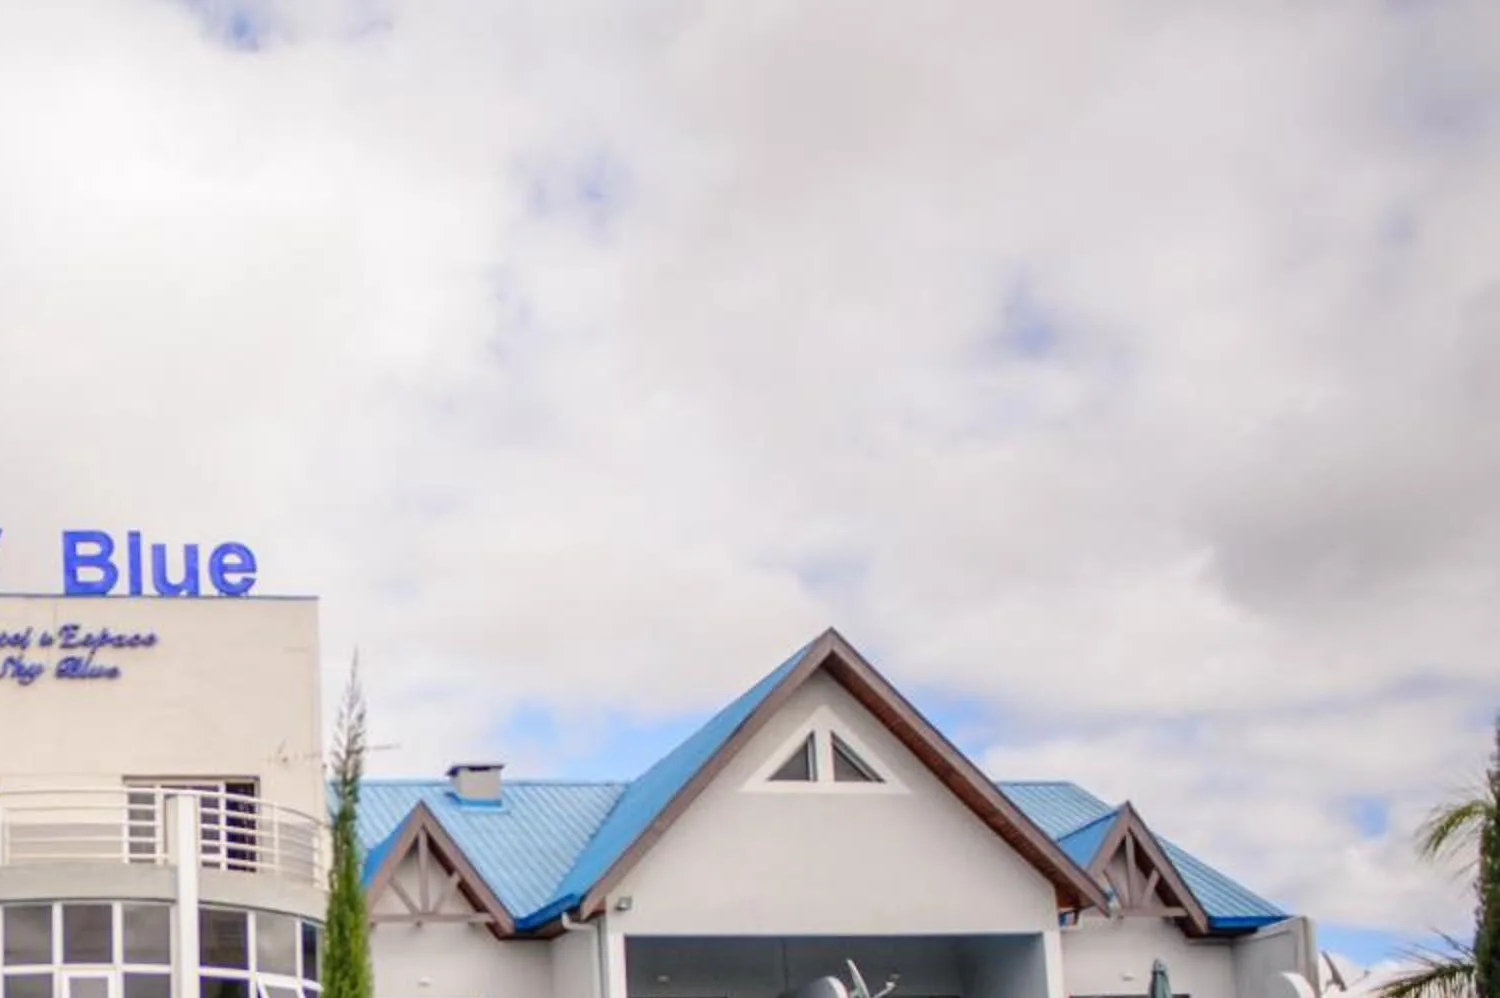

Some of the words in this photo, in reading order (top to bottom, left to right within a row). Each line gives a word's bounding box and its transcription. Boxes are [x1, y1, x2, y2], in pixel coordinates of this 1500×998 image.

[61, 529, 258, 597] Blue
[57, 623, 158, 655] Espace
[54, 655, 120, 680] Blue
